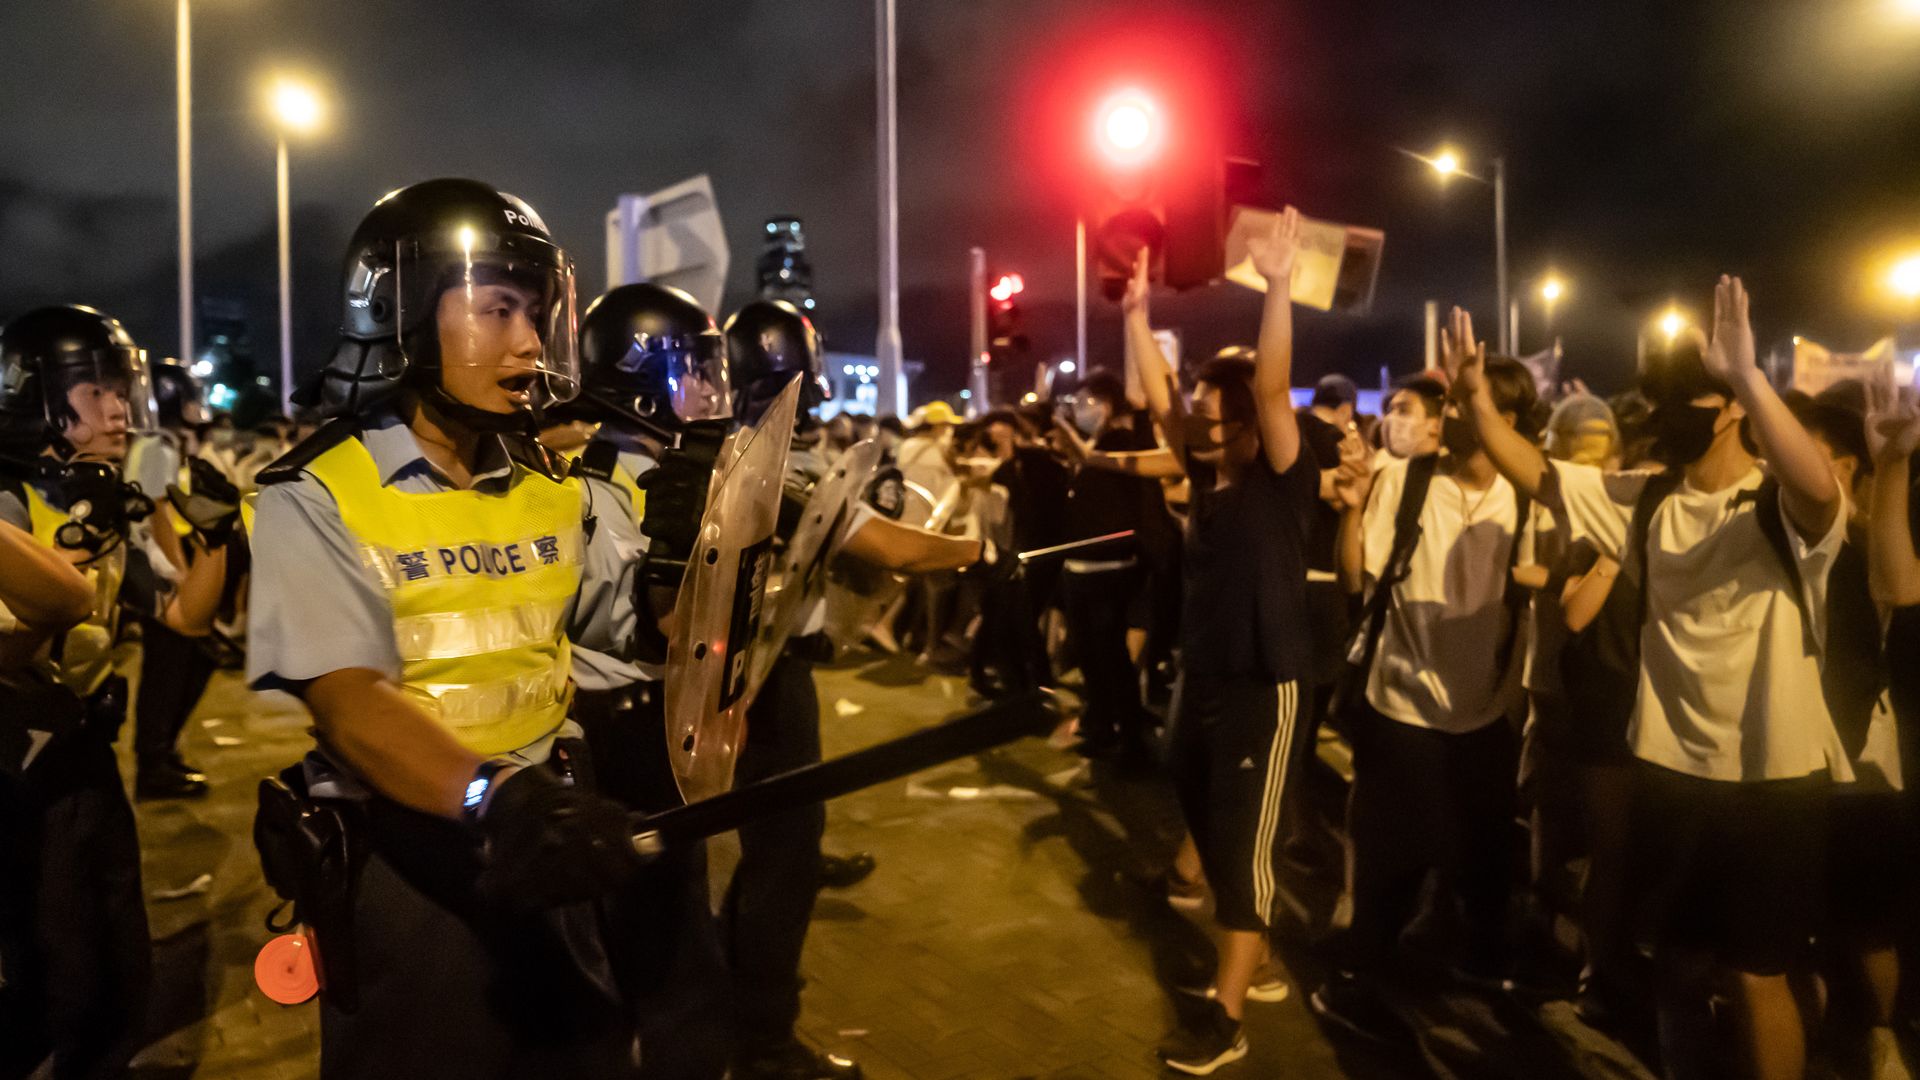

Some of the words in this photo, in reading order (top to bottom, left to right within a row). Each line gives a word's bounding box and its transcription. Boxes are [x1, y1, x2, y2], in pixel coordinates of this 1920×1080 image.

[396, 551, 430, 581] 警
[438, 543, 526, 576] POLCE
[534, 535, 559, 565] 察
